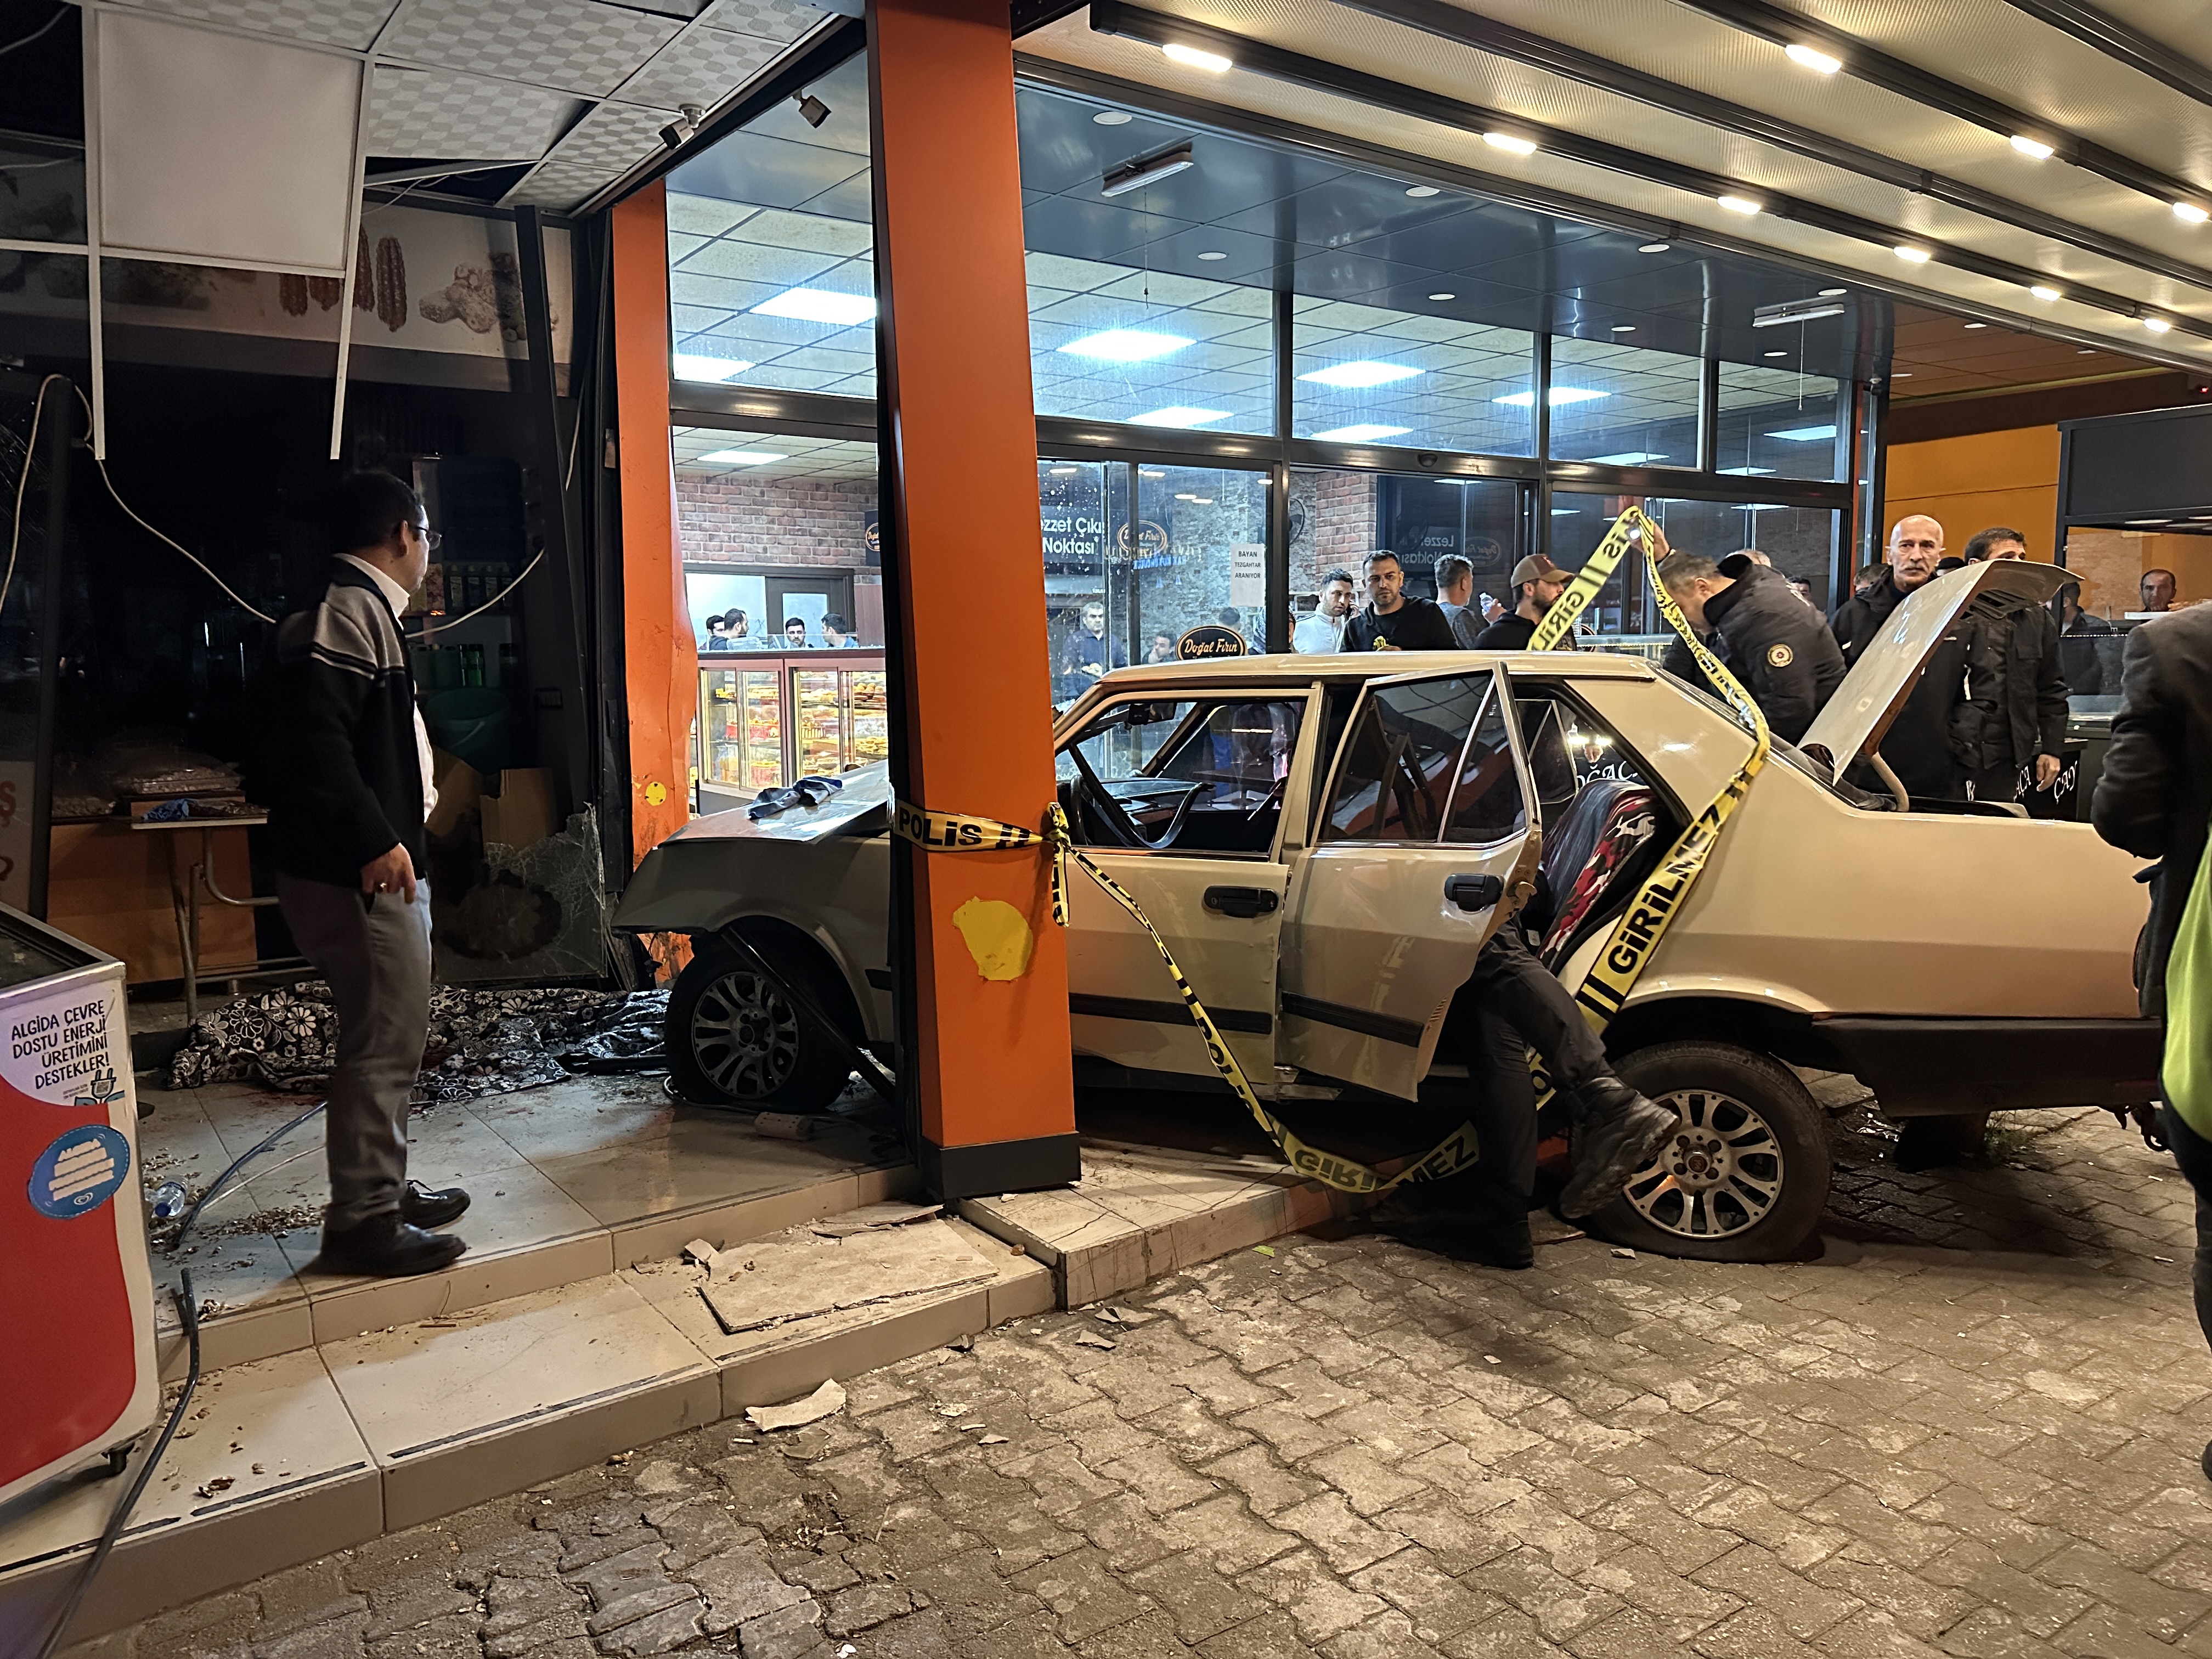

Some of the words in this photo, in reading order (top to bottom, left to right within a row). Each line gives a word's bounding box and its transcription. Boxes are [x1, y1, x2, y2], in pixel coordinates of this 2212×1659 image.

[1042, 537, 1094, 555] Noktası
[1184, 639, 1214, 656] Doğal
[2054, 760, 2078, 805] ÇAY
[12, 1014, 60, 1041] ALGİDA
[64, 1000, 105, 1026] ÇEVRE
[13, 1032, 58, 1059] DOSTU
[64, 1014, 106, 1043] ENERJİ
[42, 1032, 108, 1068] ÜRETİMİNİ
[35, 1051, 110, 1089] DESTEKLER!
